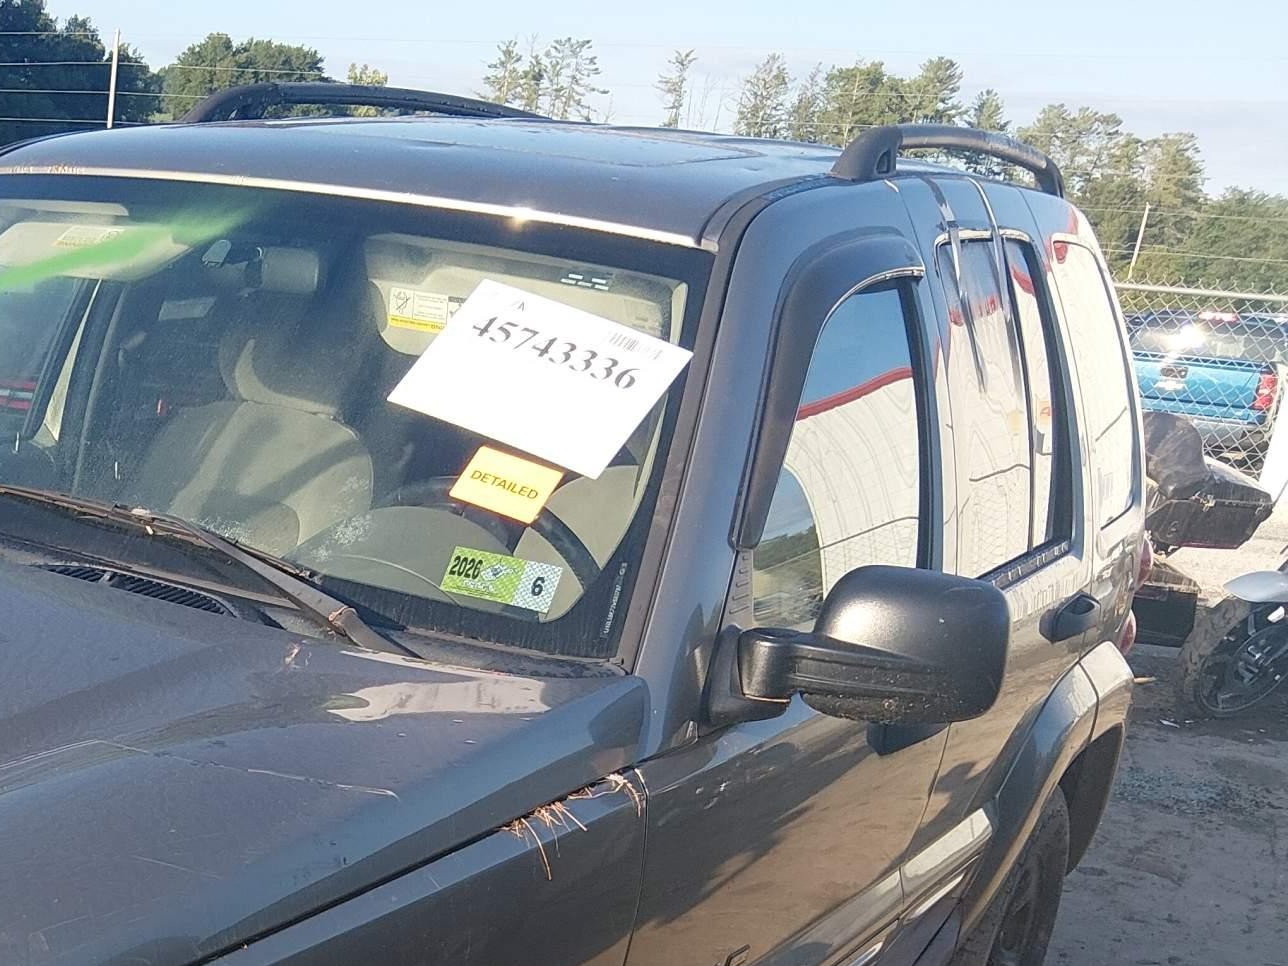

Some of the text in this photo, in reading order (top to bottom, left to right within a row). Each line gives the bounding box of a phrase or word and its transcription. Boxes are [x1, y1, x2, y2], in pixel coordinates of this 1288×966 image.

[471, 315, 642, 391] 45743336
[470, 468, 539, 501] DETAILED
[448, 555, 484, 580] 2026
[530, 576, 546, 597] 6
